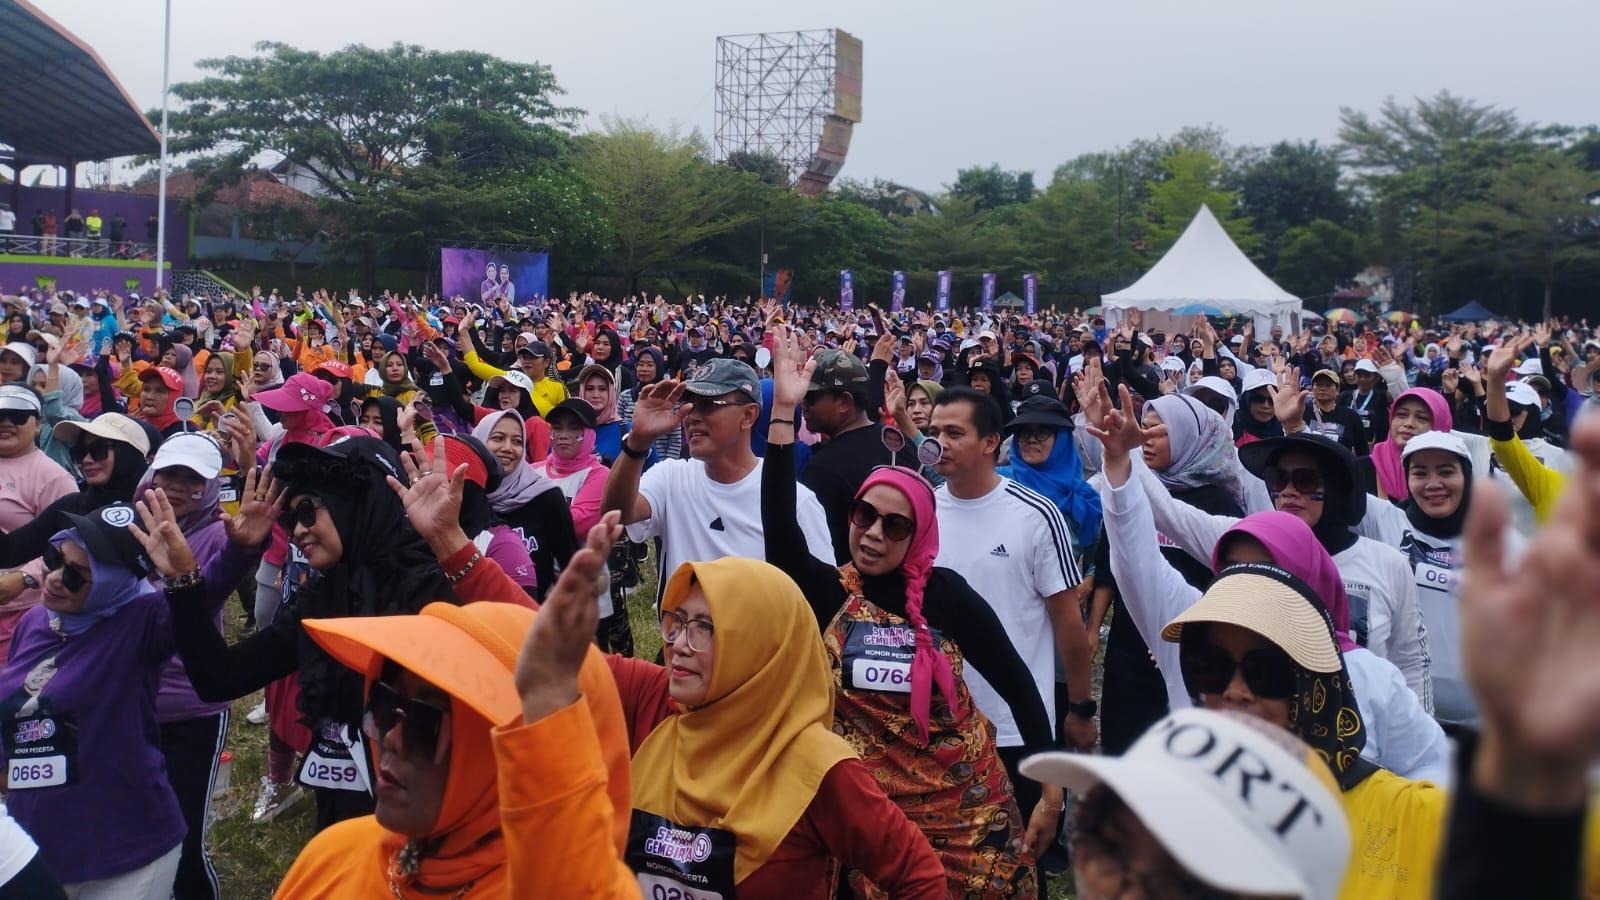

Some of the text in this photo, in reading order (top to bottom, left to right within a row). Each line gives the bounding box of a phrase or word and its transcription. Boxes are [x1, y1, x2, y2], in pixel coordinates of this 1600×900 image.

[324, 360, 348, 371] ORT
[159, 366, 183, 383] ORT
[12, 764, 54, 782] 0663
[308, 761, 357, 782] 0259
[1160, 719, 1325, 838] ORT
[675, 869, 709, 884] ERTA
